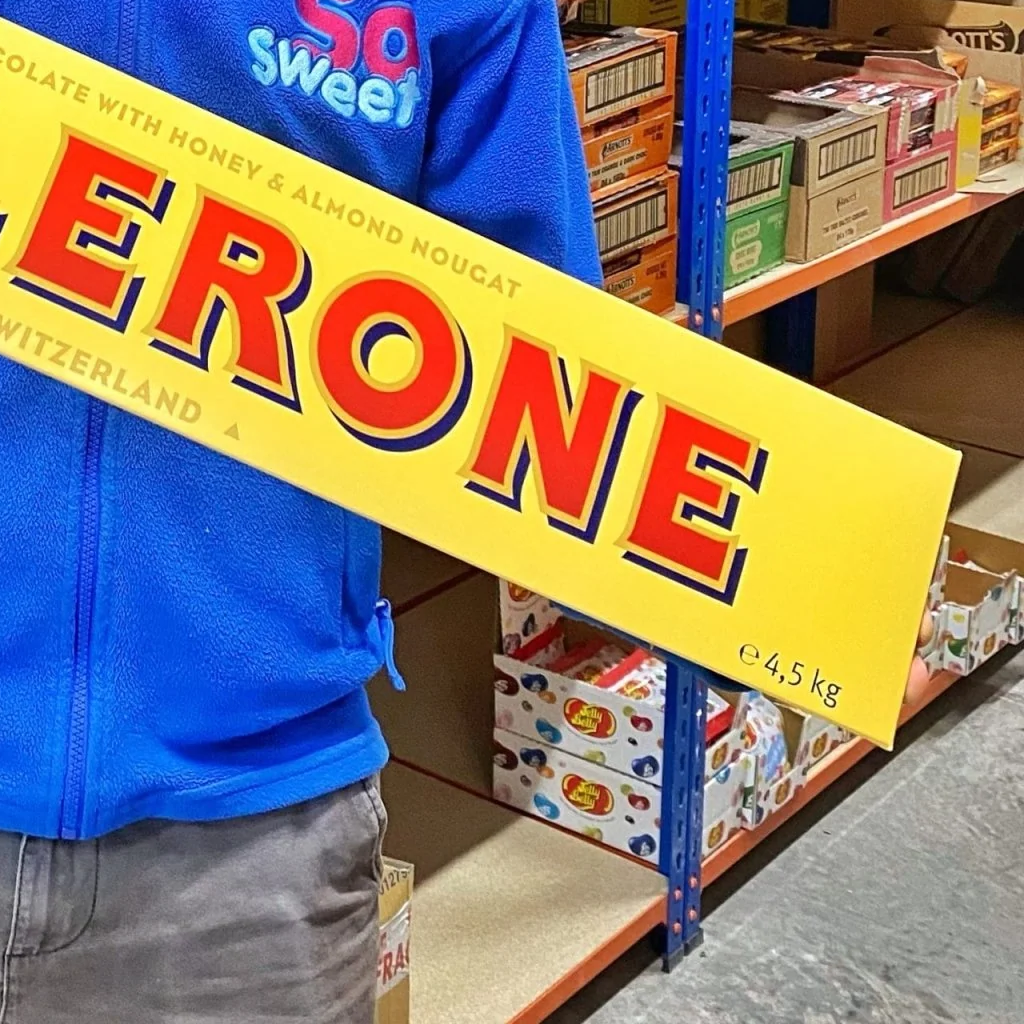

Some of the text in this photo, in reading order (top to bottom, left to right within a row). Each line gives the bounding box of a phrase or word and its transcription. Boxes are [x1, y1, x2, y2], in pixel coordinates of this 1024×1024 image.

[97, 92, 163, 137] WITH
[169, 125, 264, 180] HONEY
[267, 173, 284, 193] &
[290, 185, 405, 245] ALMOND
[411, 234, 523, 300] NOUGAT
[764, 651, 802, 687] 4,5
[811, 668, 844, 709] kg
